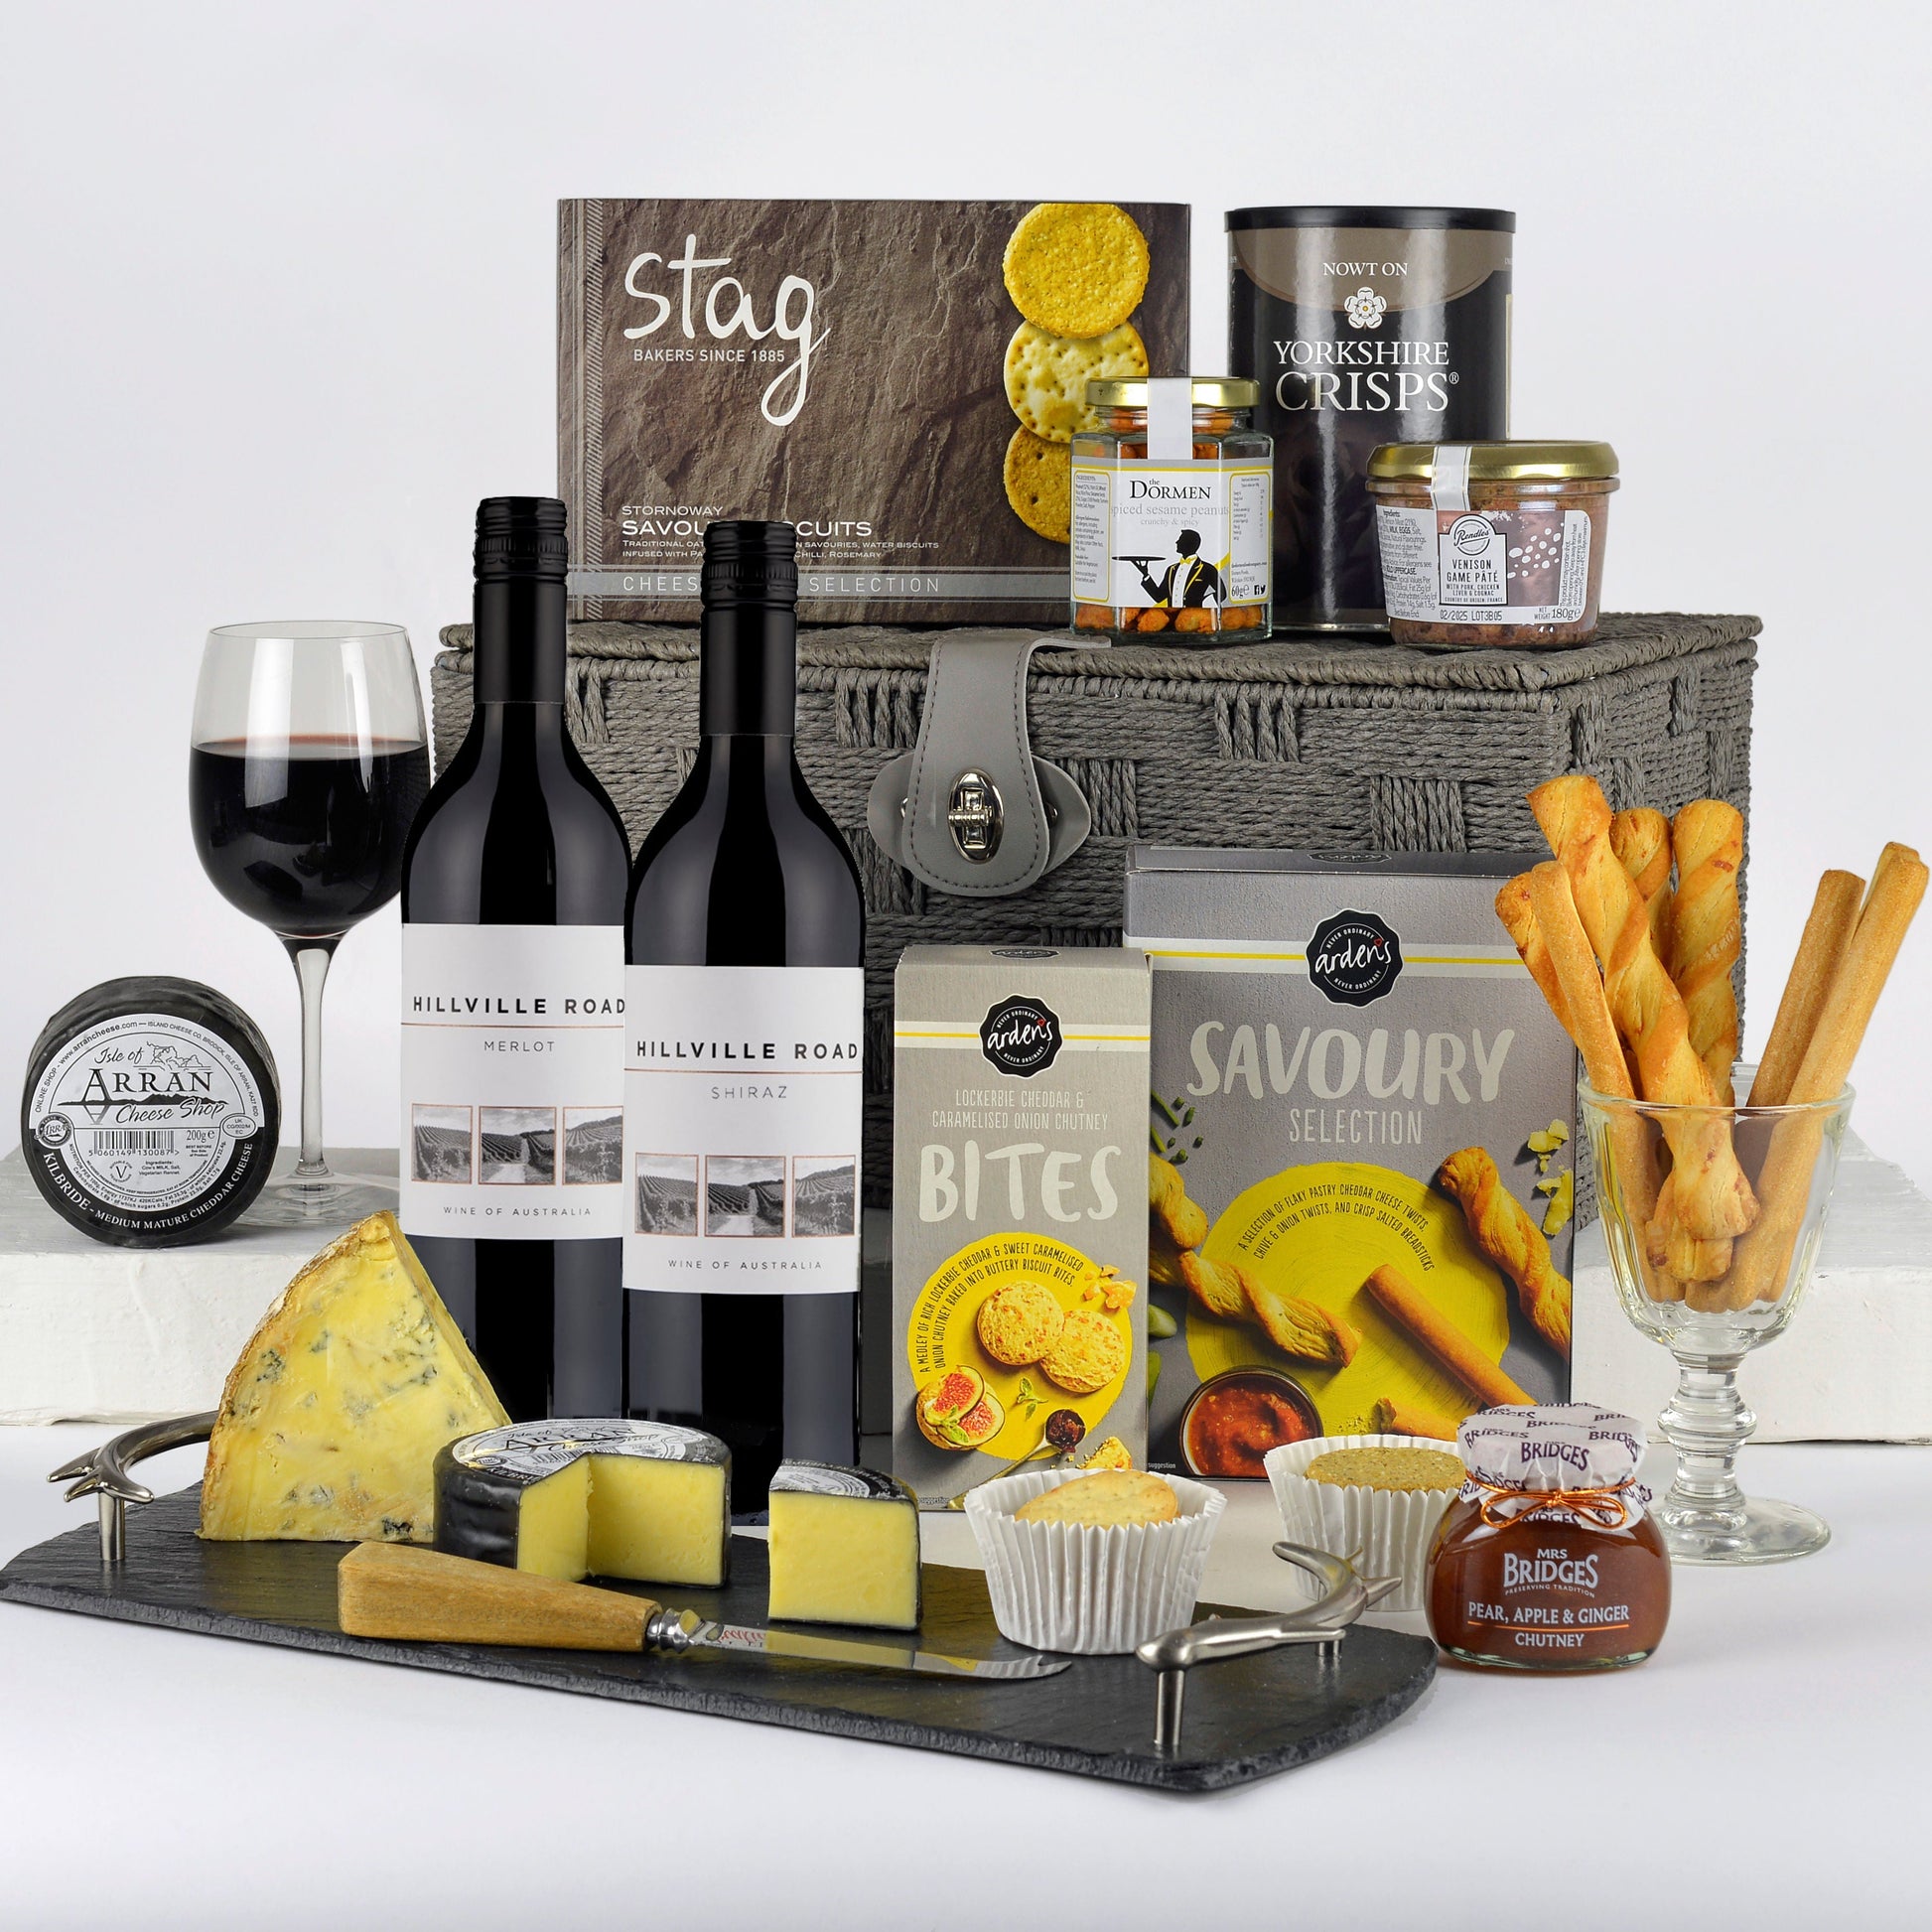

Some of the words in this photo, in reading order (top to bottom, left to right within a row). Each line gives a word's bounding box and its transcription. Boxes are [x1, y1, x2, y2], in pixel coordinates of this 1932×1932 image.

[1323, 262, 1378, 277] NOWT
[1381, 262, 1409, 277] ON
[633, 348, 695, 362] BAKERS
[700, 348, 746, 362] SINCE
[751, 349, 785, 362] 1885
[1273, 341, 1449, 366] YORKSHIRE
[1130, 480, 1212, 499] DORMEN
[621, 505, 723, 516] STORNOWAY
[1146, 506, 1187, 515] sesame
[622, 520, 707, 536] SAVOU
[782, 520, 872, 537] CUITS
[1141, 517, 1170, 527] crunchy
[1452, 559, 1491, 570] VENISON
[623, 576, 698, 592] CHEES
[809, 577, 939, 593] SELECTION
[1447, 571, 1470, 583] GAME
[1475, 569, 1498, 583] PÂTÉ
[1325, 931, 1342, 949] NEVER
[1343, 927, 1375, 939] ORDINARY
[1333, 977, 1353, 990] NEVER
[1354, 969, 1382, 990] ORDINARY
[414, 997, 546, 1015] HILLVILLE
[565, 998, 625, 1015] ROAD
[94, 1046, 124, 1064] Isle
[127, 1046, 144, 1065] of
[483, 1040, 555, 1052] MERLOT
[637, 1041, 775, 1059] HILLVILLE
[794, 1043, 858, 1060] ROAD
[35, 1086, 49, 1113] ONLINE
[44, 1067, 58, 1087] SHOP
[60, 1021, 138, 1065] www.arrancheese.com
[1186, 1021, 1515, 1106] SAVOURY
[80, 1067, 214, 1102] ARRAN
[711, 1086, 788, 1100] SHIRAZ
[955, 1089, 1016, 1107] LOCKERBIE
[1021, 1090, 1070, 1108] CHEDDAR
[1076, 1091, 1084, 1108] &
[115, 1104, 174, 1124] Cheese
[180, 1097, 225, 1120] Shop
[932, 1110, 1009, 1129] CARAMELISED
[1014, 1112, 1049, 1130] ONION
[1055, 1112, 1108, 1131] CHUTNEY
[1290, 1108, 1423, 1145] SELECTION
[43, 1152, 91, 1210] KILBRIDE
[94, 1209, 140, 1229] MEDIUM
[143, 1213, 190, 1229] MATURE
[189, 1180, 235, 1218] CHEDDAR
[230, 1143, 253, 1182] CHEESE
[918, 1140, 1122, 1223] BITES
[1309, 1183, 1336, 1199] PASTRY
[1339, 1183, 1374, 1199] CHEDDAR
[1273, 1200, 1285, 1214] OF
[1284, 1189, 1308, 1208] FLAKY
[1375, 1190, 1404, 1211] CHEESE
[444, 1206, 477, 1215] WINE
[485, 1207, 503, 1216] OF
[1402, 1204, 1429, 1233] TWISTS,
[1242, 1207, 1276, 1244] SELECTION
[1238, 1241, 1249, 1251] A
[1253, 1236, 1274, 1260] CHIVE
[1276, 1212, 1301, 1234] ONION
[1300, 1202, 1332, 1220] TWISTS,
[1334, 1201, 1351, 1213] AND
[1353, 1202, 1376, 1218] CRISP
[1376, 1210, 1404, 1232] SALTED
[1400, 1227, 1436, 1272] BREADSTICKS
[1003, 1242, 1031, 1256] SWEET
[1033, 1242, 1084, 1272] CARAMELISED
[668, 1260, 703, 1269] WINE
[712, 1261, 730, 1270] OF
[740, 1261, 822, 1270] AUSTRALIA
[958, 1247, 993, 1273] CHEDDAR
[984, 1258, 1021, 1278] BUTTERY
[1023, 1258, 1052, 1274] BISCUIT
[928, 1266, 961, 1303] LOCKERBIE
[965, 1270, 986, 1287] INTO
[1052, 1266, 1077, 1288] BITES.
[945, 1283, 969, 1308] BAKED
[920, 1300, 935, 1320] RICH
[917, 1319, 929, 1332] OF
[931, 1305, 953, 1337] CHUTNEY
[916, 1331, 929, 1366] MEDLEY
[931, 1334, 947, 1369] ONION
[1477, 1410, 1536, 1419] RIDGES
[1464, 1429, 1529, 1449] BRIDGES
[1521, 1442, 1590, 1470] BRIDGES
[1537, 1548, 1568, 1559] MRS
[1503, 1553, 1598, 1588] BRIDGES
[1505, 1585, 1550, 1595] PRESERVING
[1553, 1585, 1595, 1598] TRADITION
[1468, 1601, 1509, 1623] PEAR,
[1513, 1606, 1559, 1624] APPLE
[1563, 1607, 1574, 1623] &
[1578, 1604, 1629, 1623] GINGER
[1515, 1632, 1585, 1647] CHUTNEY
